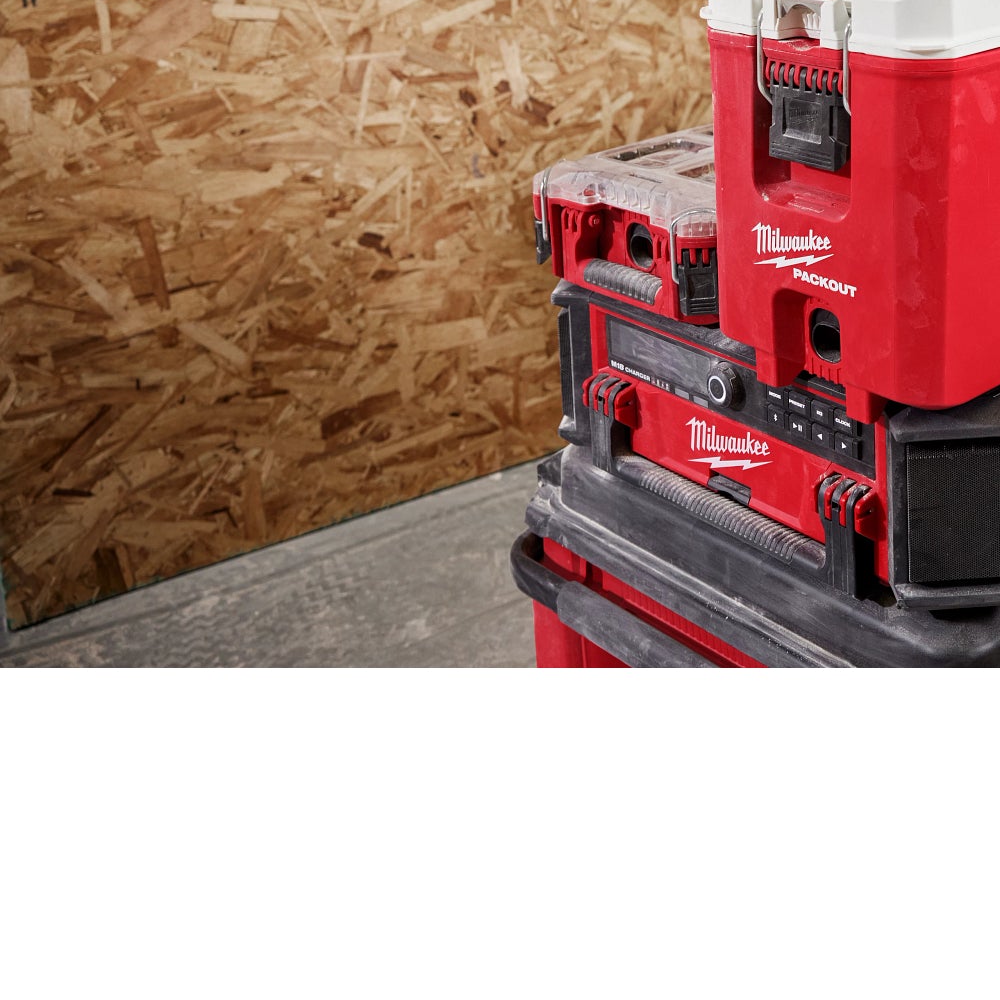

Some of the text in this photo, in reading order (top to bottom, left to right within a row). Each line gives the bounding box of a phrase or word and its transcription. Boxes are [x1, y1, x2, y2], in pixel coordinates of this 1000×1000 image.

[751, 222, 832, 255] Milwaukee
[793, 267, 857, 298] PACKOUT
[624, 366, 651, 382] CHARGER
[685, 417, 772, 456] Milwaukee
